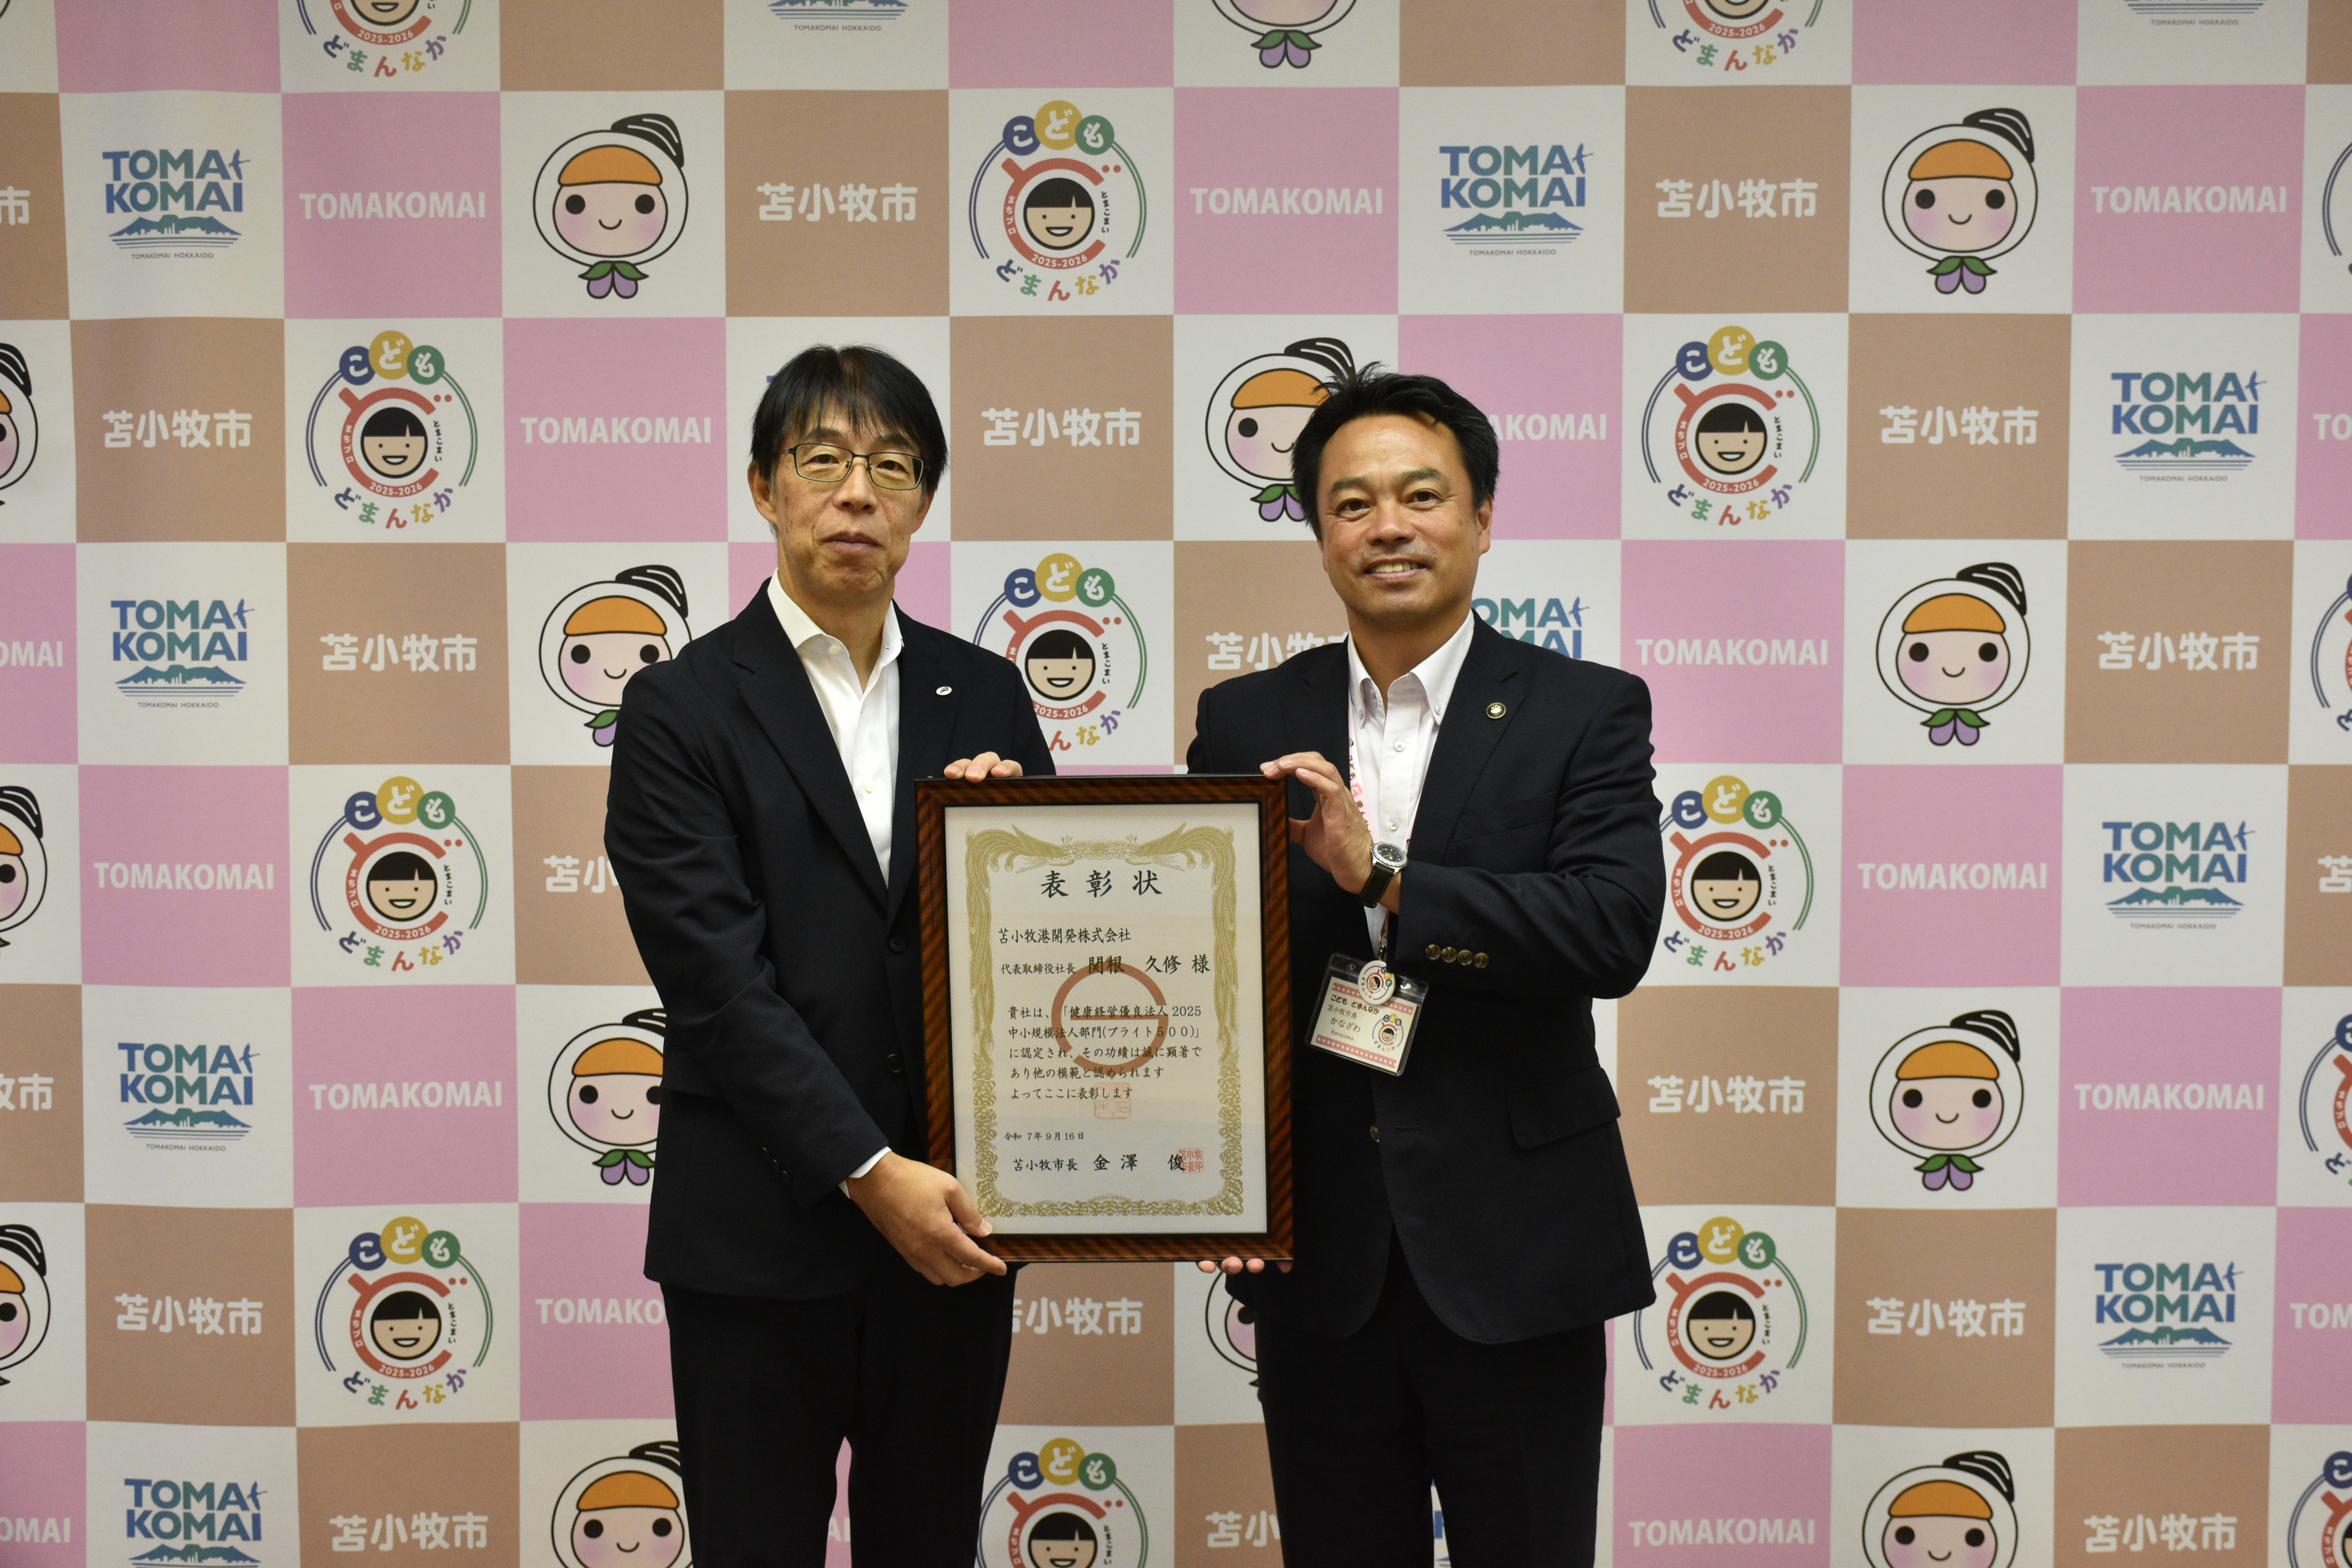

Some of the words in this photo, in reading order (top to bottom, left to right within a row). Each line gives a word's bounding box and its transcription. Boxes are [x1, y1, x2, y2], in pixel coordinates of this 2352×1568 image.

[358, 30, 414, 44] 2025-2026
[1708, 23, 1765, 37] 2025-2026
[323, 35, 447, 78] どまんなか
[1672, 28, 1798, 72] どまんなか
[1013, 109, 1104, 148] こども
[102, 149, 231, 181] TOMA
[1439, 145, 1575, 176] TOMA
[105, 181, 243, 213] KOMAI
[299, 192, 485, 219] TOMAKOMAI
[757, 183, 917, 222] 苫小牧市
[1191, 188, 1382, 214] TOMAKOMAI
[1441, 177, 1585, 208] KOMAI
[1656, 178, 1818, 218] 苫小牧市
[2091, 186, 2286, 213] TOMAKOMAI
[1031, 254, 1087, 268] 2025-2026
[996, 259, 1120, 301] どまんなか
[348, 339, 435, 378] こども
[1686, 334, 1778, 374] こども
[2111, 371, 2248, 403] TOMA
[103, 409, 252, 448] 苫小牧市
[521, 417, 711, 443] TOMAKOMAI
[982, 408, 1141, 446] 苫小牧市
[1489, 414, 1607, 441] AKOMAI
[1880, 406, 2038, 445] 苫小牧市
[2112, 403, 2258, 435] KOMAI
[369, 482, 422, 496] 2025-2026
[1702, 479, 1759, 492] 2025-2026
[336, 487, 454, 529] どまんなか
[1667, 484, 1792, 526] どまんなか
[1014, 561, 1104, 601] こども
[111, 600, 235, 630] TOMA
[1471, 598, 1571, 628] OMA
[113, 631, 247, 662] KOMAI
[320, 633, 477, 672] 苫小牧市
[1636, 639, 1828, 665] TOMAKOMAI
[2098, 632, 2259, 670] 苫小牧市
[1033, 704, 1088, 718] 2025-2026
[1049, 710, 1121, 751] んなか
[355, 784, 446, 823] こども
[1681, 784, 1772, 823] こども
[2102, 821, 2237, 852] TOMA
[94, 863, 274, 890] TOMAKOMAI
[1858, 863, 2047, 889] TOMAKOMAI
[2103, 852, 2247, 884] KOMAI
[374, 926, 431, 939] 2025-2026
[998, 927, 1132, 944] 苫小牧港開発株式会社
[1698, 926, 1754, 939] 2025-2026
[339, 930, 464, 972] どまんなか
[1662, 930, 1786, 972] どまんなか
[1000, 962, 1076, 975] 代表取締役社長
[1330, 994, 1347, 1005] こども
[1330, 1016, 1360, 1033] かなざわ
[118, 1043, 242, 1075] TOMA
[120, 1074, 253, 1106] KOMAI
[309, 1081, 501, 1110] TOMAKOMAI
[1011, 1087, 1133, 1100] よってここに表彰します
[1647, 1075, 1805, 1114] 苫小牧市
[2074, 1083, 2263, 1110] TOMAKOMAI
[1013, 1158, 1078, 1171] 苫小牧市長
[359, 1224, 450, 1263] こども
[1677, 1225, 1766, 1263] こども
[2094, 1263, 2225, 1292] TOMA
[115, 1294, 263, 1335] 苫小牧市
[535, 1298, 665, 1325] TOMAKO
[1012, 1296, 1143, 1335] 小牧市
[1867, 1298, 2025, 1337] 苫小牧市
[2096, 1293, 2235, 1323] KOMAI
[379, 1364, 435, 1378] 2025-2026
[1693, 1364, 1748, 1377] 2025-2026
[343, 1368, 468, 1411] どまんなか
[1659, 1369, 1780, 1410] どまんなか
[1018, 1445, 1106, 1484] こども
[124, 1479, 251, 1511] TOMA
[125, 1509, 260, 1543] KOMAI
[330, 1512, 488, 1551] 苫小牧市
[1628, 1518, 1814, 1546] TOMAKOMAI
[2084, 1513, 2237, 1553] 苫小牧市
